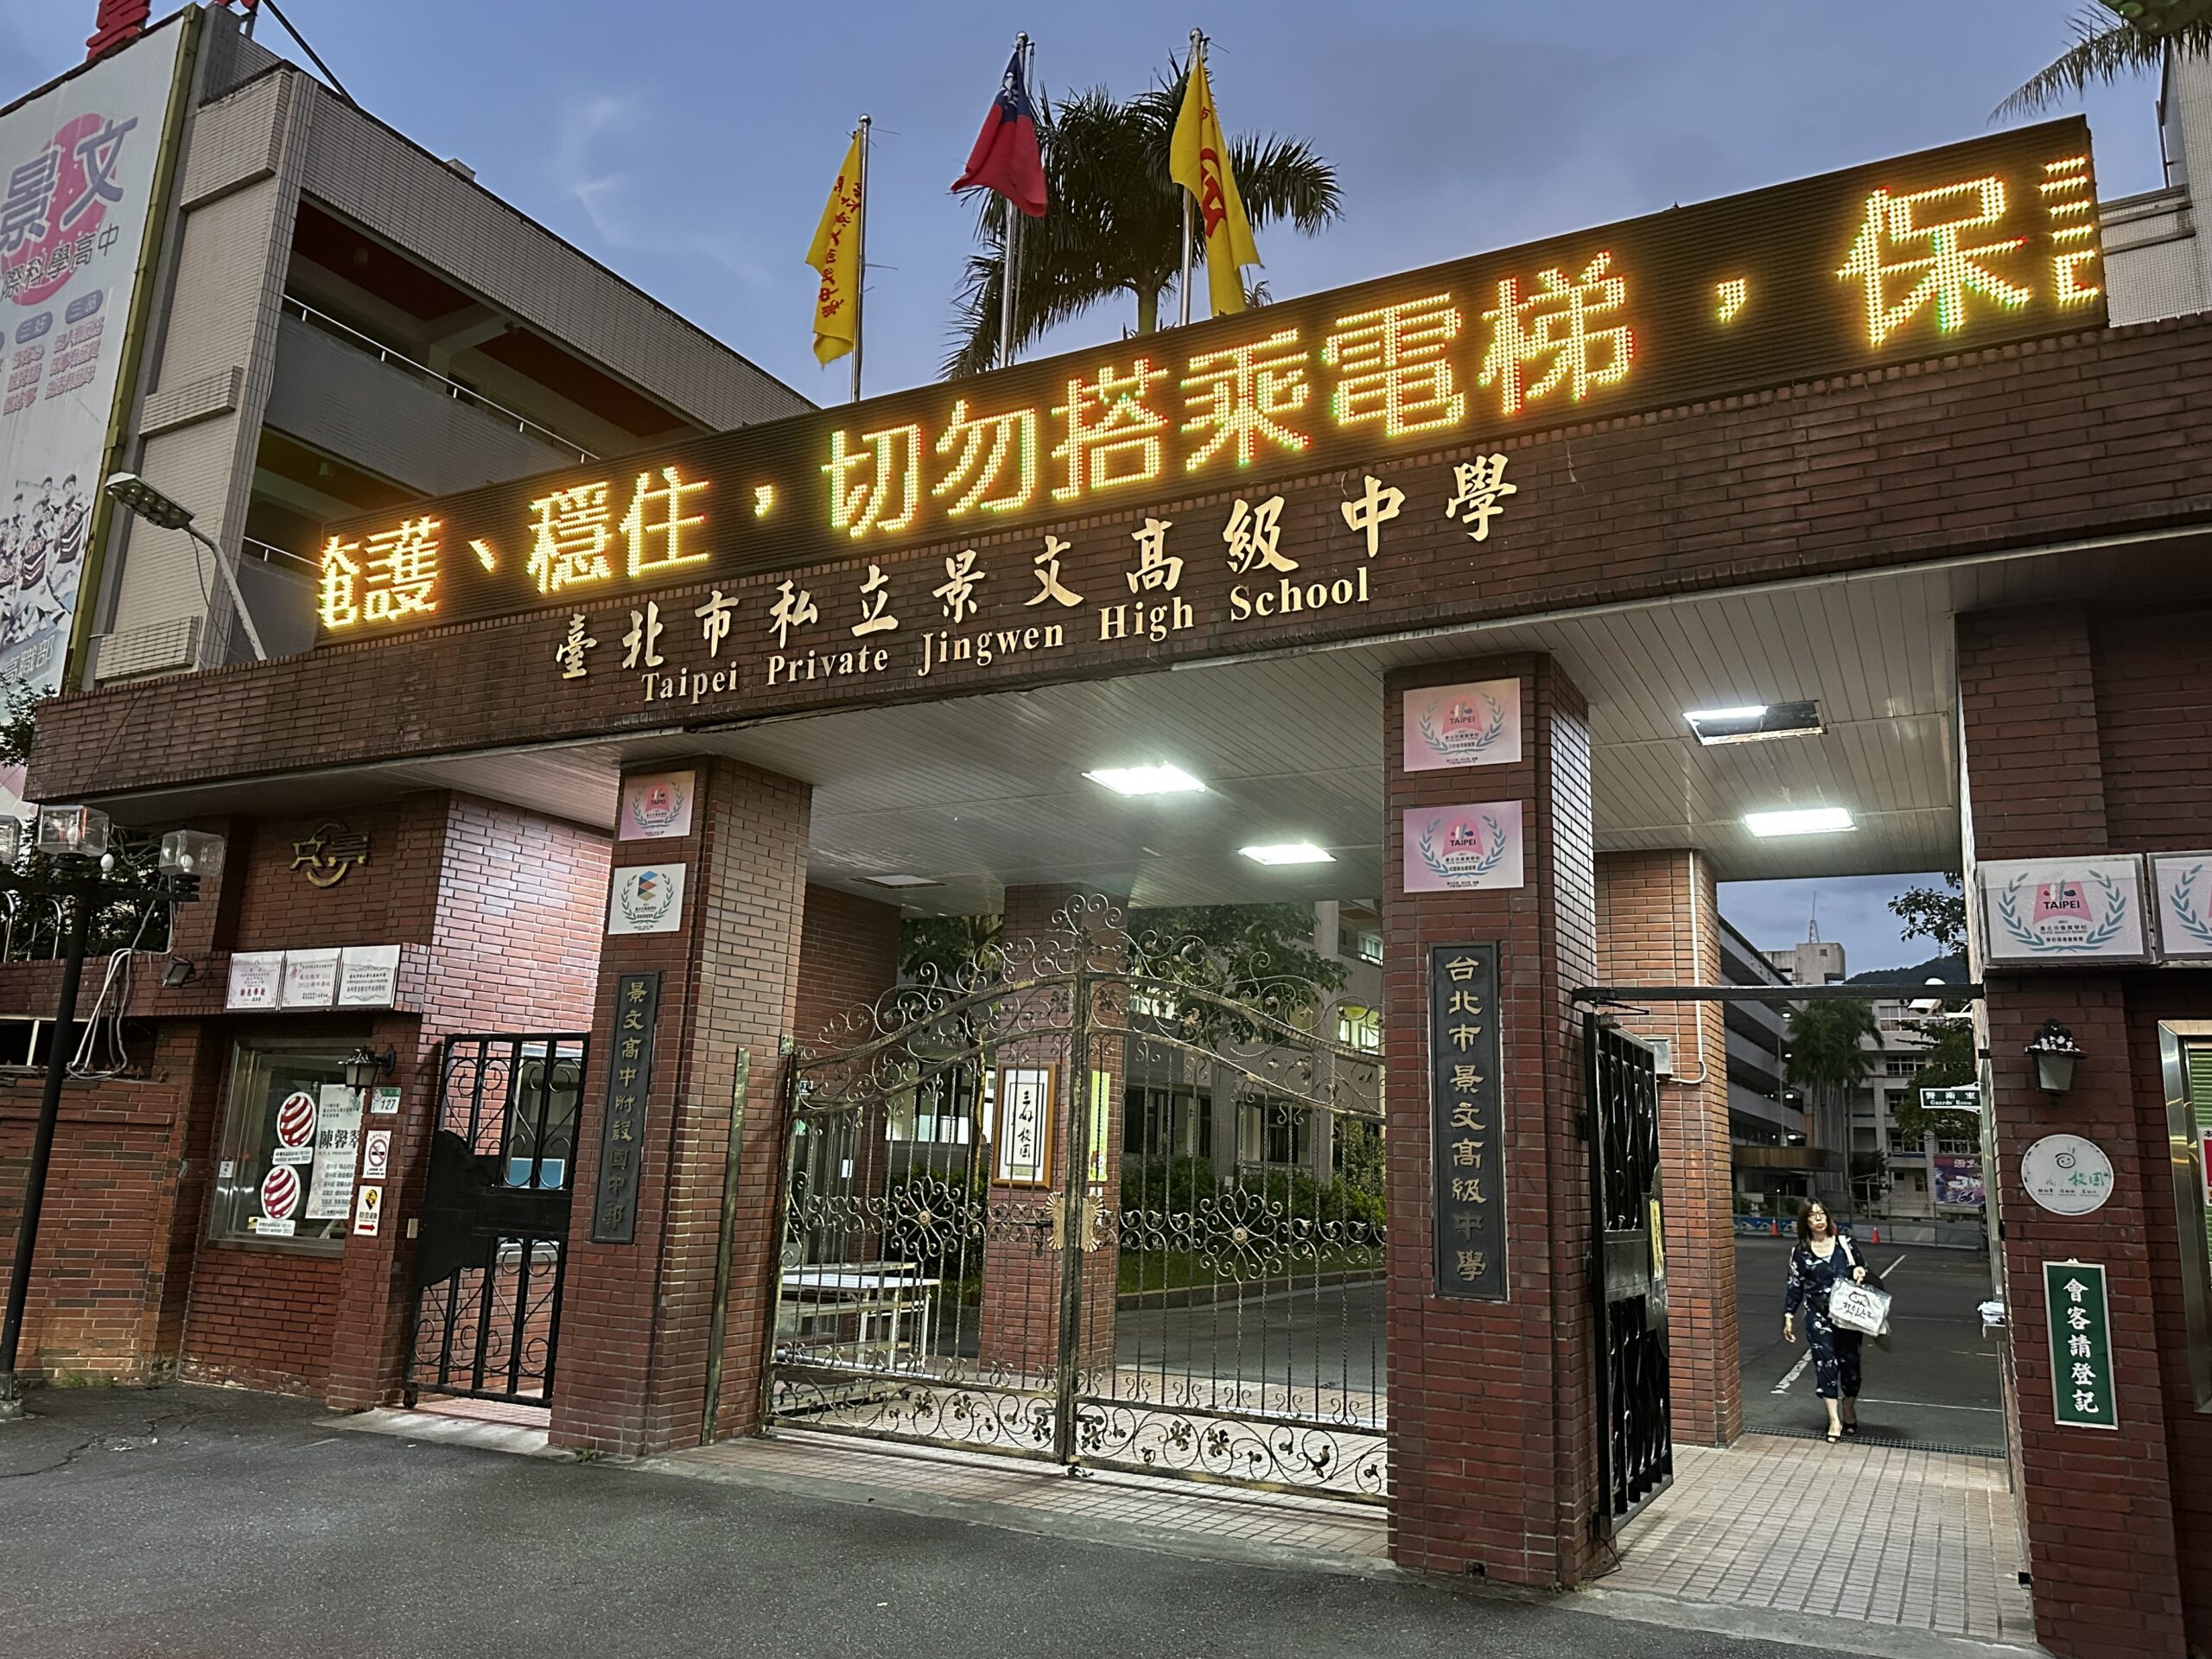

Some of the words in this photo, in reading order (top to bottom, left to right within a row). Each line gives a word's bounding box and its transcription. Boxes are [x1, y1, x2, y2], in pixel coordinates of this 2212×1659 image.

[0, 117, 138, 253] 景文
[0, 224, 119, 301] 際科學高中
[556, 453, 1517, 681] 臺北市私立景文高級中學
[642, 661, 737, 705] Taipei
[766, 644, 889, 686] Private
[918, 623, 1064, 677] Jingwen
[1097, 597, 1195, 642] High
[1230, 568, 1370, 622] School
[1450, 838, 1477, 847] TAIPEI
[2044, 900, 2081, 910] TAIPEI
[381, 1099, 397, 1110] 127
[604, 981, 648, 1231] 景文高中附設國中部
[1446, 956, 1487, 1282] 台北市景文高級中學
[2063, 1278, 2100, 1414] 會客請登記
